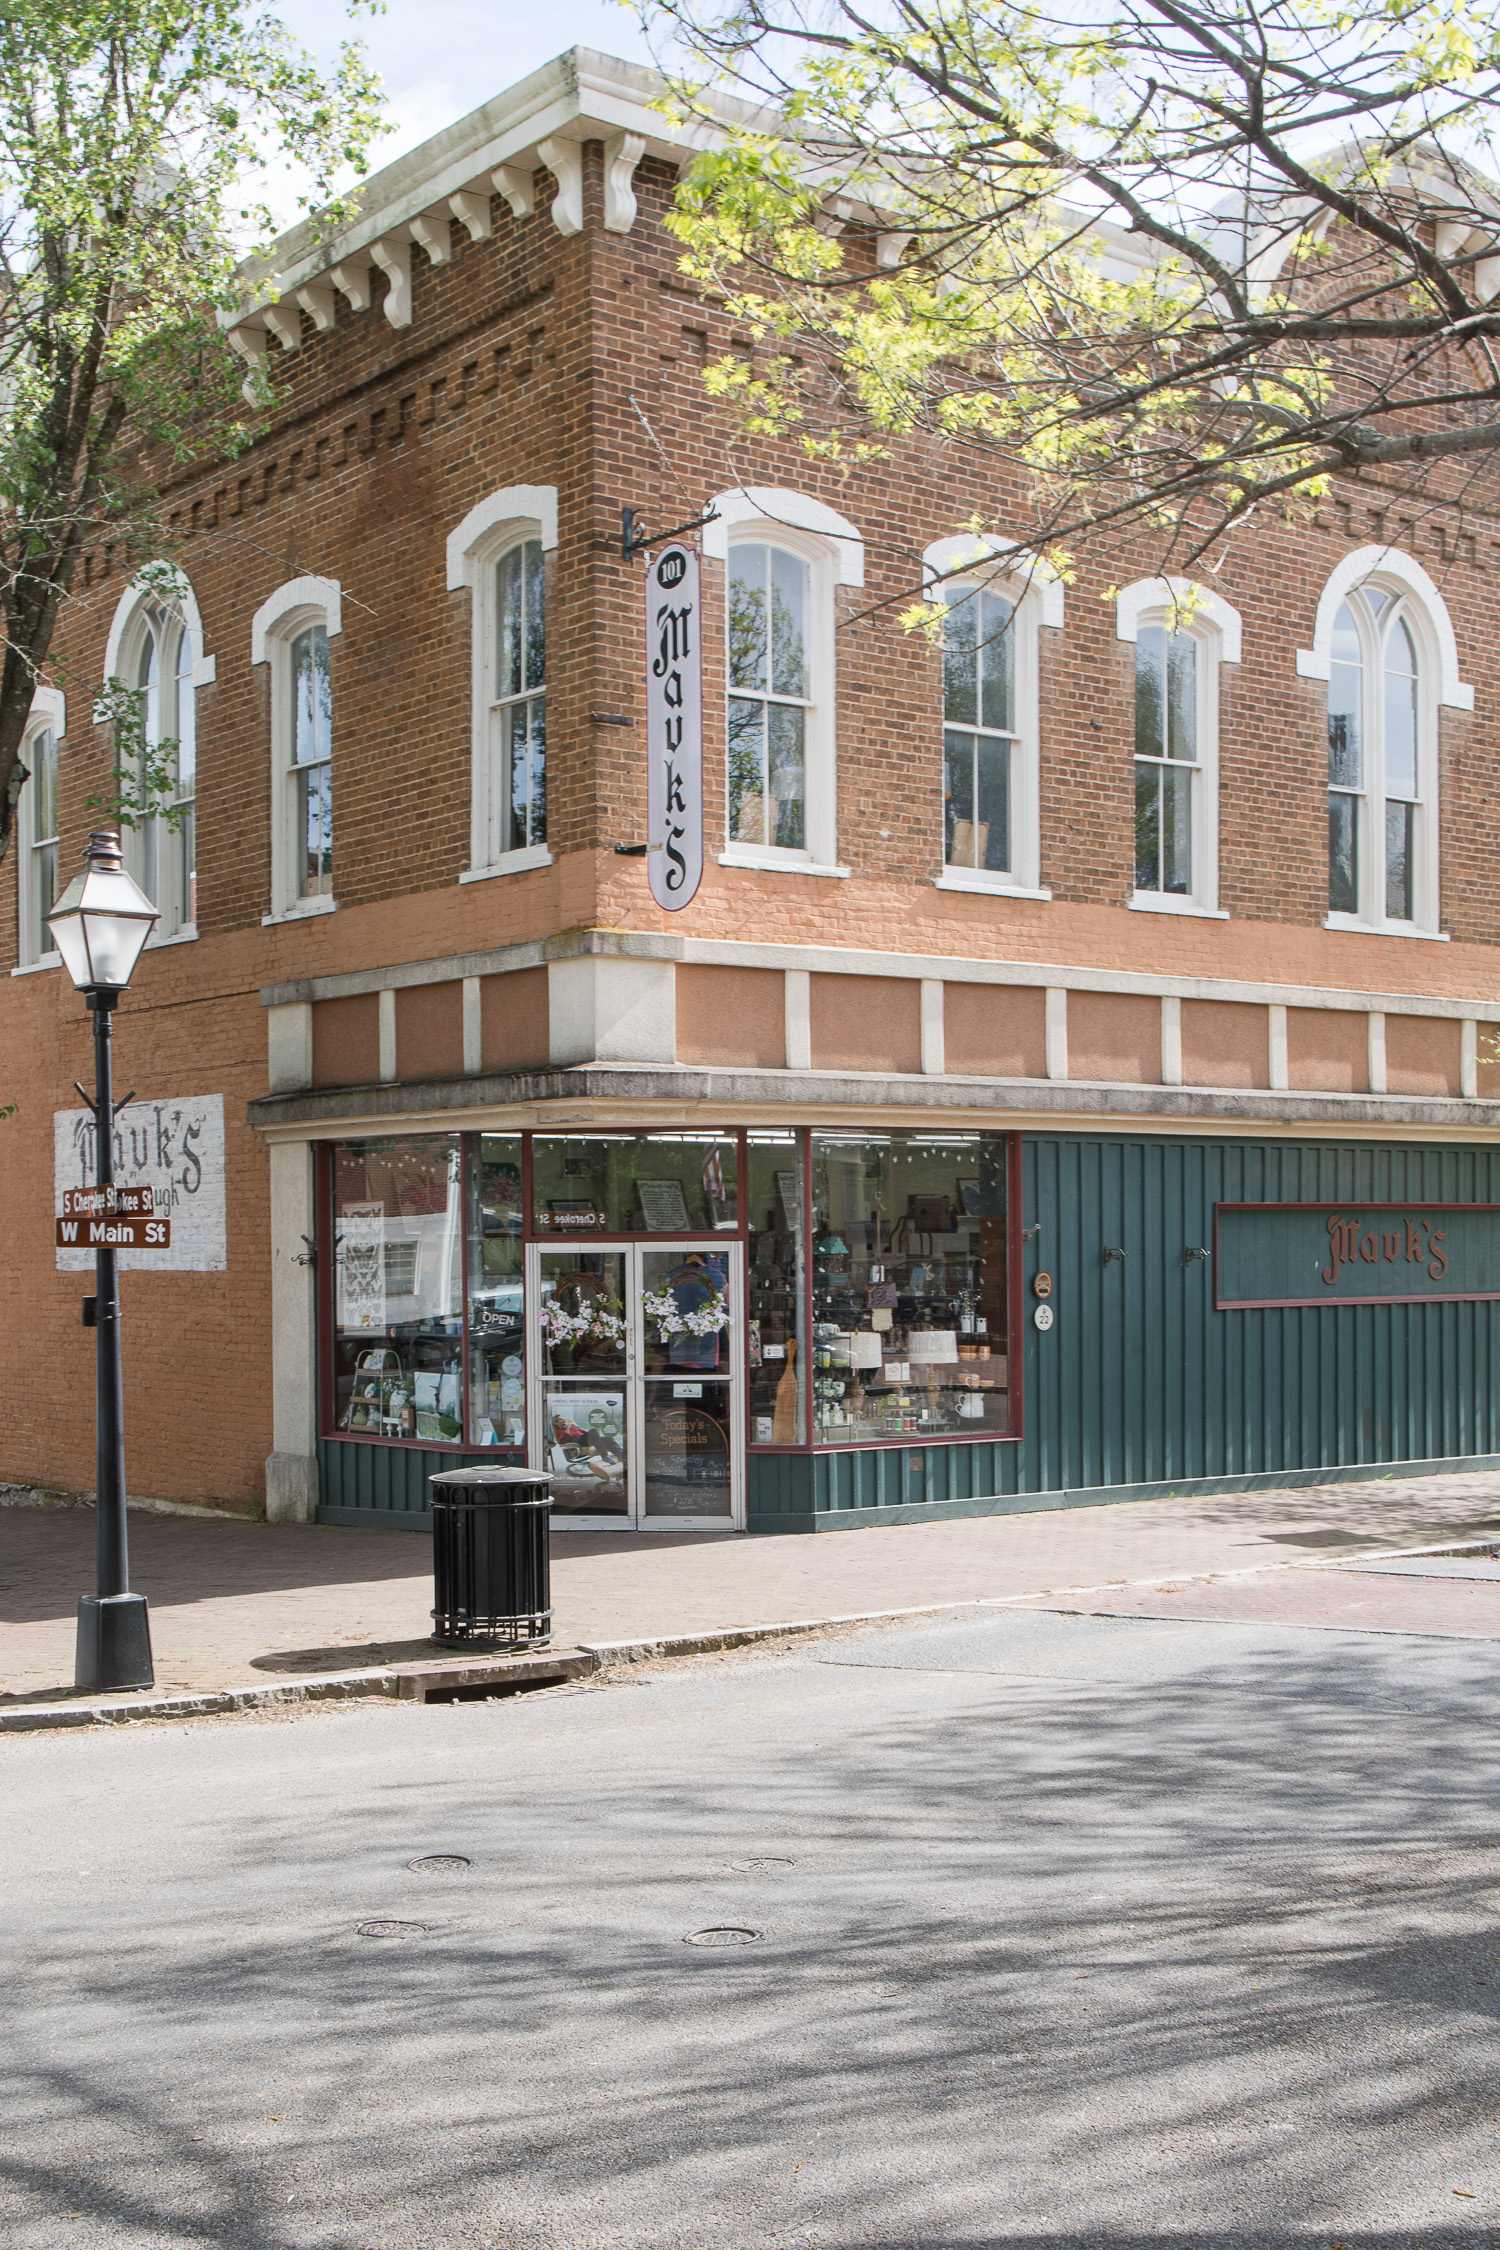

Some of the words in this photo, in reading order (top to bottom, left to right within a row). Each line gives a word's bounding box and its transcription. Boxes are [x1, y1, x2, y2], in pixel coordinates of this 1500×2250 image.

[660, 558, 682, 583] 101
[64, 1193, 71, 1213] S
[142, 1190, 153, 1211] St
[61, 1222, 79, 1242] W
[89, 1222, 134, 1243] Main
[145, 1222, 166, 1243] St
[482, 1312, 515, 1326] OPEN
[1039, 1315, 1049, 1325] 22
[662, 1418, 705, 1432] Today's
[661, 1433, 708, 1448] Specials
